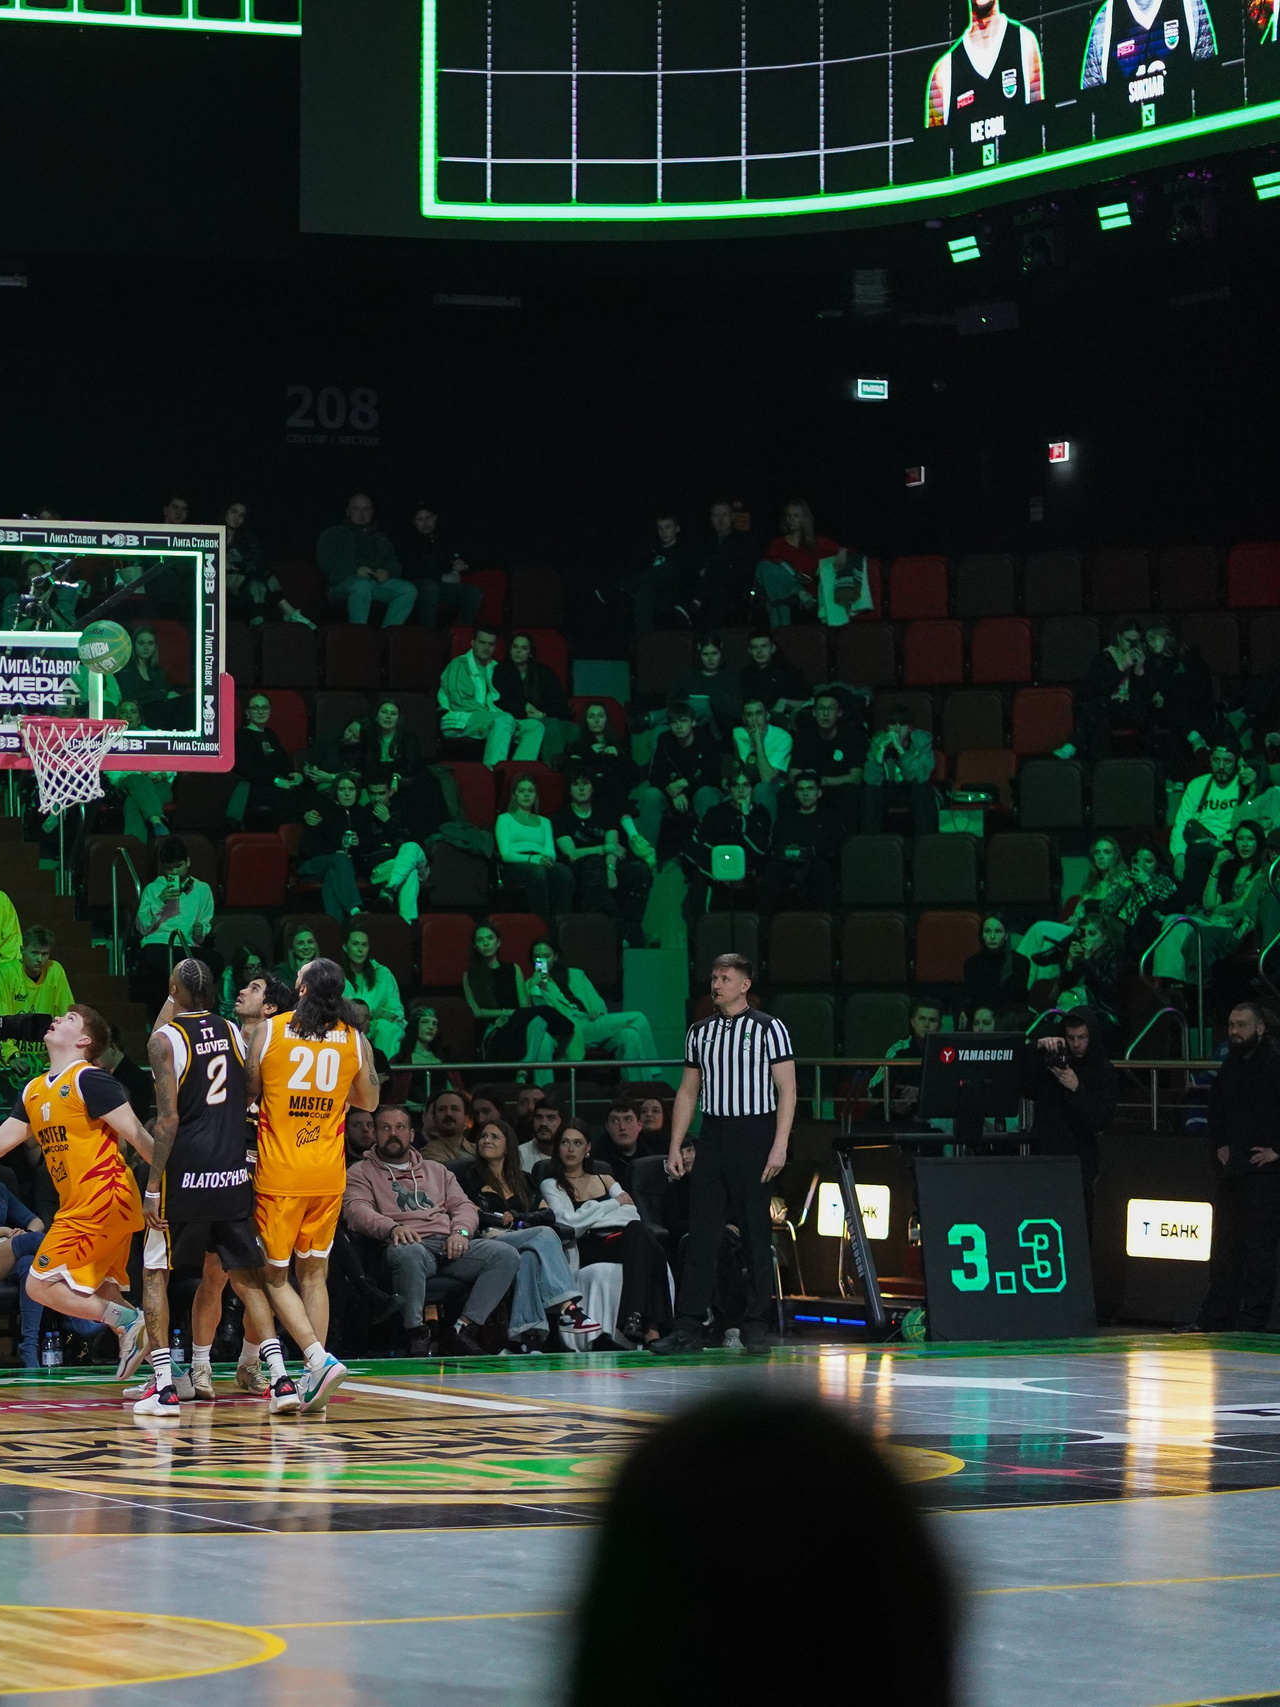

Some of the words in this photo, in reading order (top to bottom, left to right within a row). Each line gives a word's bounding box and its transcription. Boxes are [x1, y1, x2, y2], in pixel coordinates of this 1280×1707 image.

[286, 385, 380, 430] 208
[201, 1027, 215, 1040] TY
[195, 1039, 230, 1055] GLOVER
[958, 1049, 1014, 1061] YAMAGUCHI
[287, 1046, 341, 1092] 20
[206, 1054, 228, 1105] 2
[40, 1101, 52, 1122] 16
[289, 1095, 334, 1112] MASTER
[1160, 1223, 1199, 1240] БАНК
